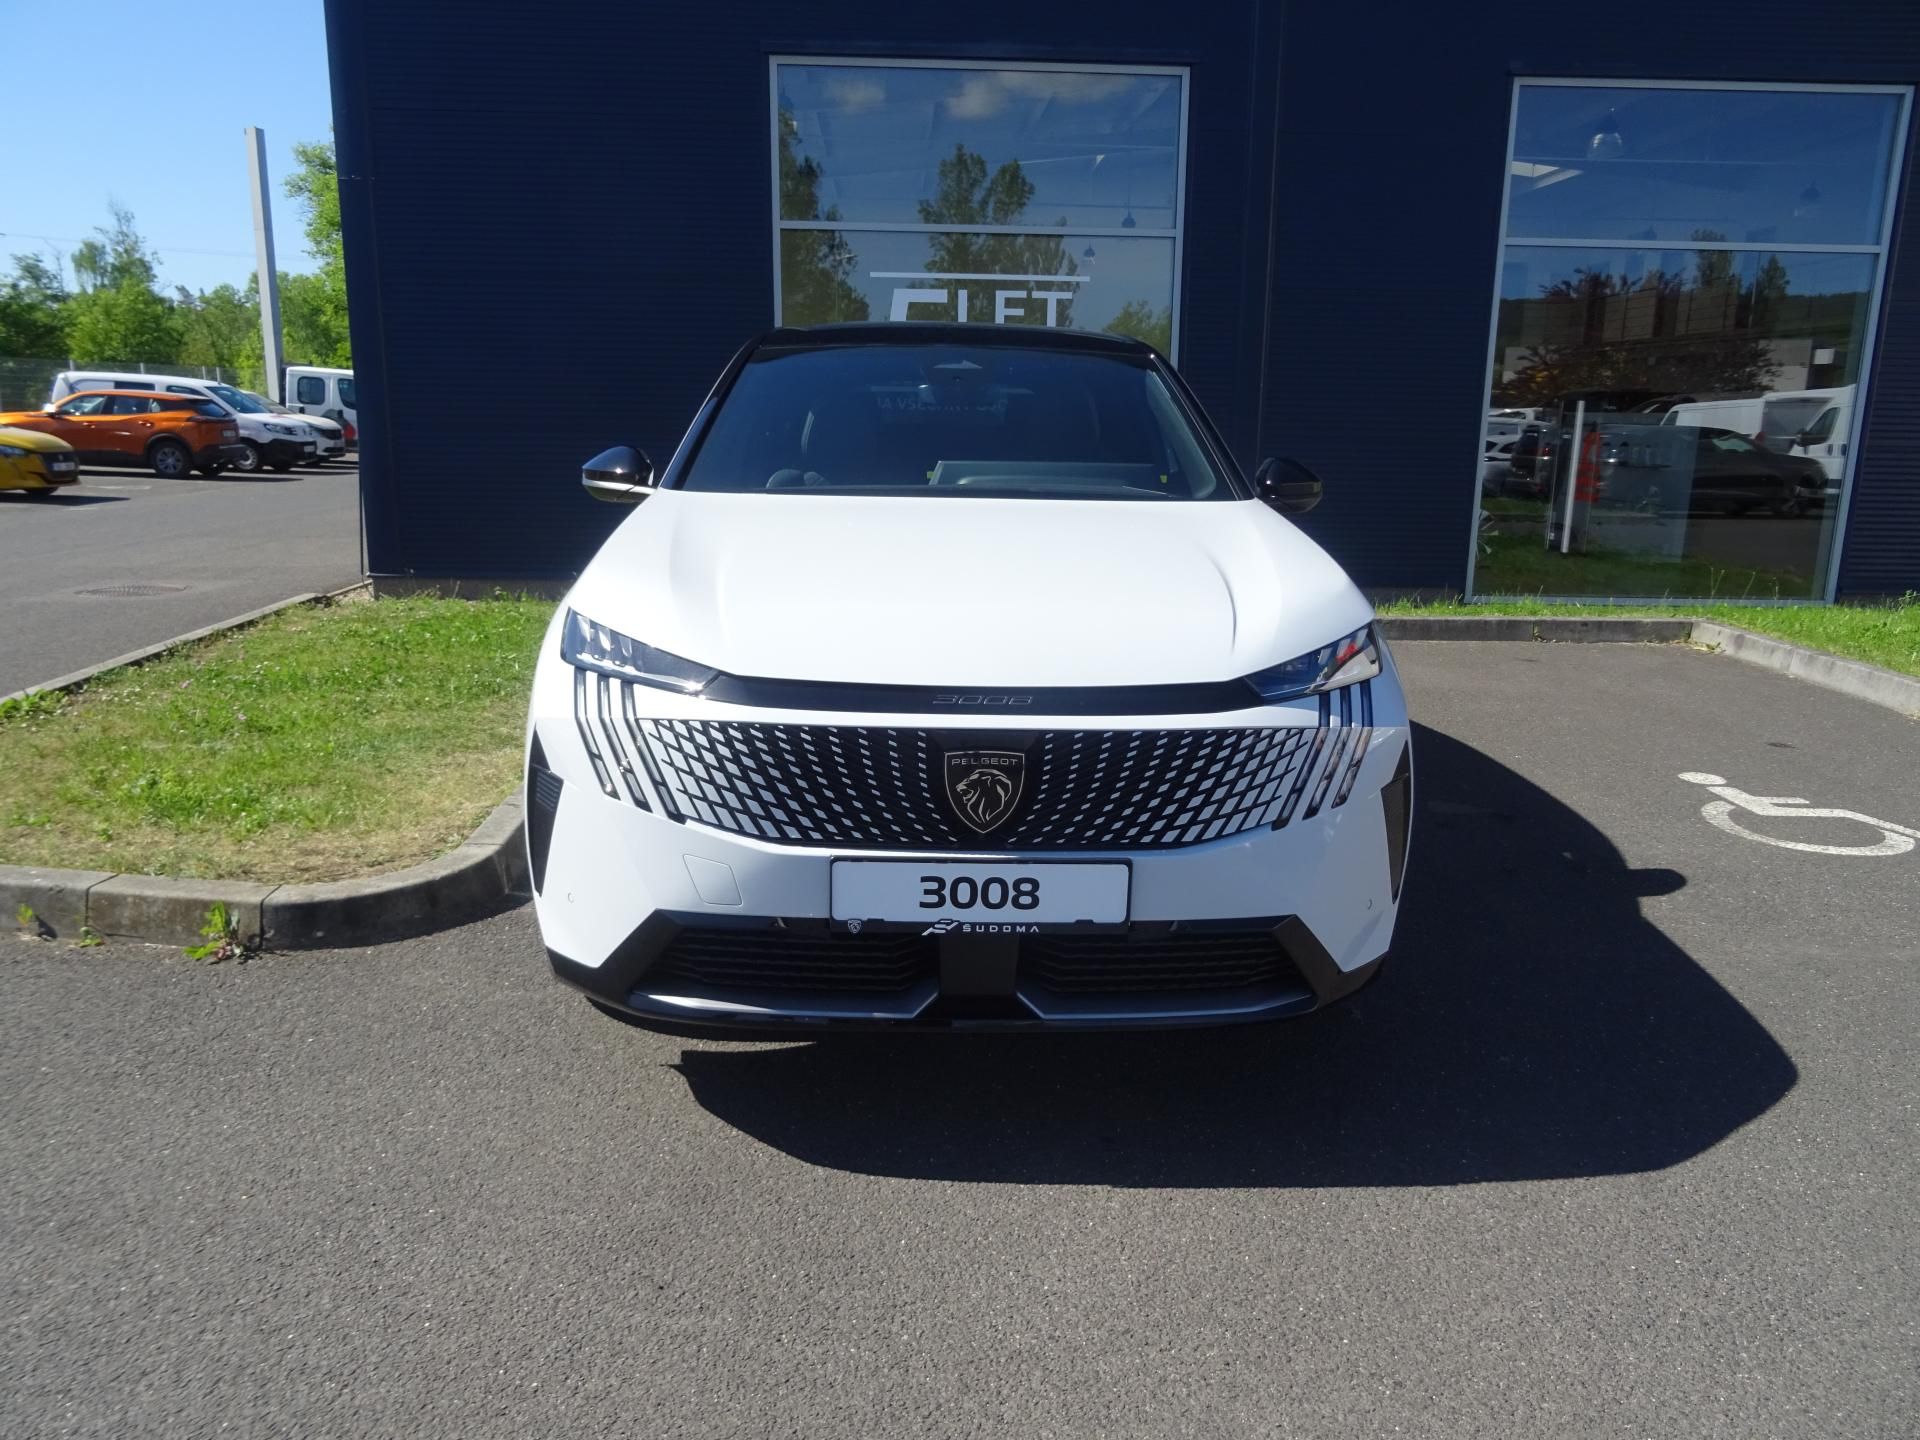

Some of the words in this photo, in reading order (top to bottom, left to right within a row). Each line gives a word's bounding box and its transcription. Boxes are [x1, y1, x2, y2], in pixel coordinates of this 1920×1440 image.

[932, 694, 1034, 705] 3008
[951, 757, 1019, 766] PEUGEOT
[918, 875, 1040, 910] 3008
